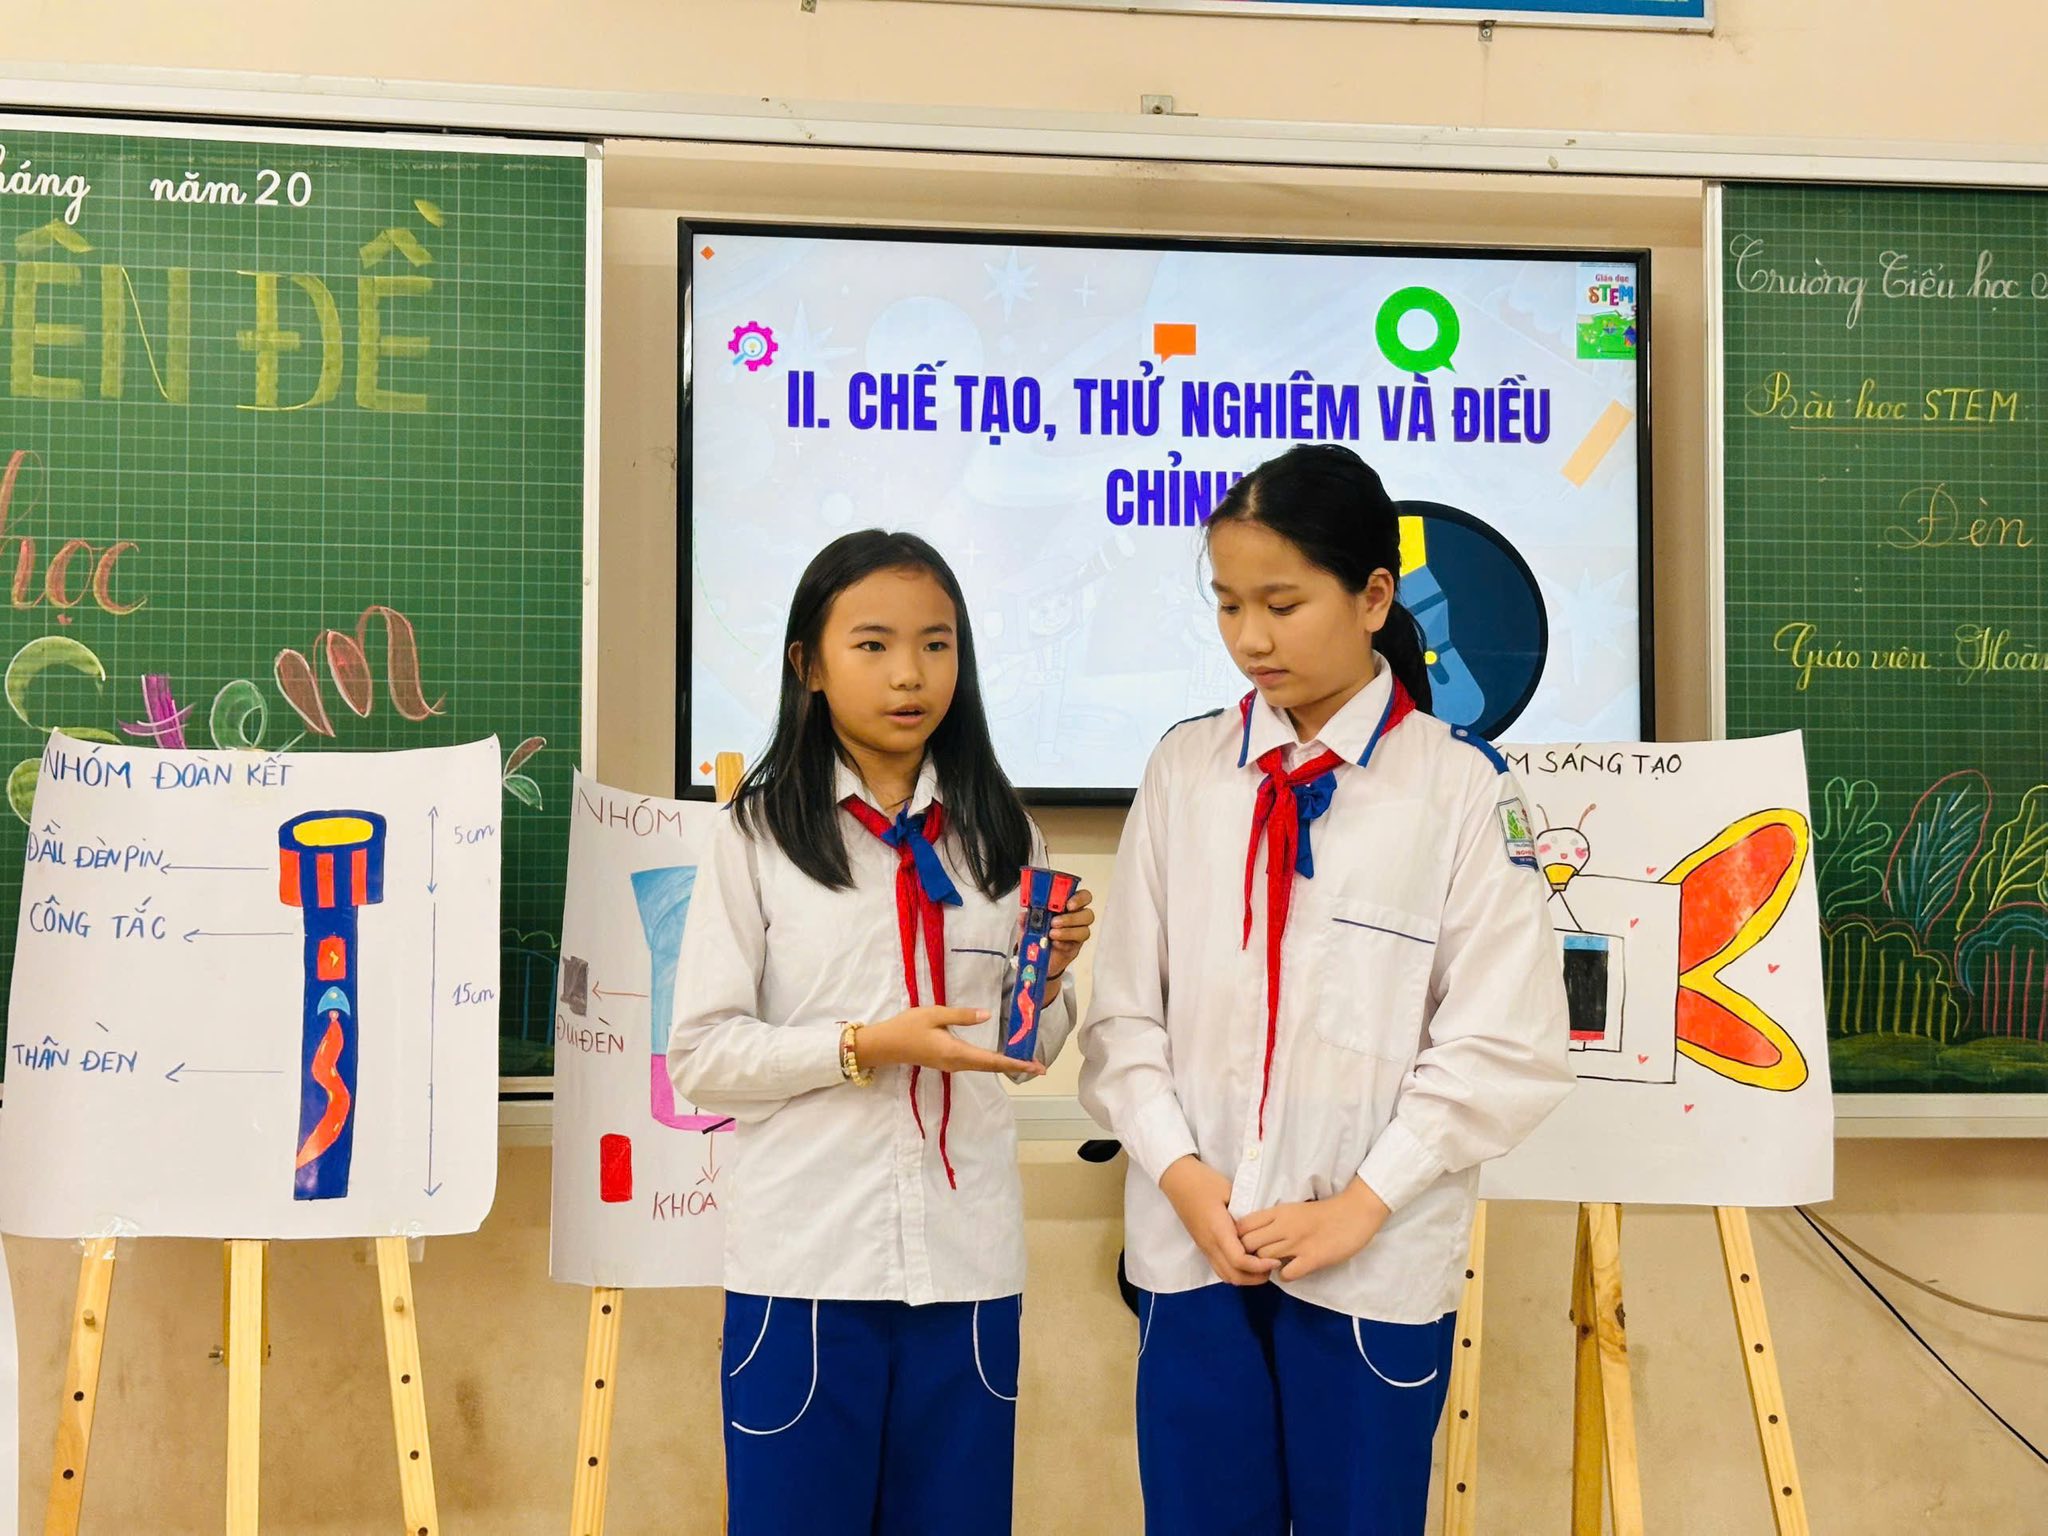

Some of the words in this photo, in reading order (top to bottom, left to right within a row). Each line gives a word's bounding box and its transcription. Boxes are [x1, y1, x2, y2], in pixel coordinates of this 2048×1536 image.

[150, 171, 247, 204] năm
[255, 169, 312, 207] 20
[1588, 283, 1634, 307] STEM
[1879, 250, 1957, 299] Tiểu
[0, 218, 190, 402] ÊN
[236, 199, 445, 413] ĐỀ
[787, 370, 830, 428] II.
[848, 360, 948, 431] CHẾ
[954, 375, 1057, 445] TẠO,
[1073, 360, 1166, 437] THỬ
[1377, 371, 1437, 443] VÀ
[1451, 374, 1551, 444] ĐIỀU
[1744, 371, 1836, 419] Bài
[1884, 482, 2034, 549] Đèn
[1773, 622, 1860, 691] Giáo
[43, 746, 132, 789] NHÓM
[151, 756, 233, 790] ĐOÀN
[247, 752, 294, 787] KẾT
[1537, 742, 1624, 776] SÁNG
[1631, 752, 1682, 781] TẠO
[577, 786, 683, 838] NHÓM
[74, 836, 122, 869] ĐÈN
[29, 894, 92, 938] CÔNG
[112, 896, 166, 940] TẮC
[80, 1021, 138, 1074] ĐÈN
[653, 1177, 719, 1221] KHÓA
